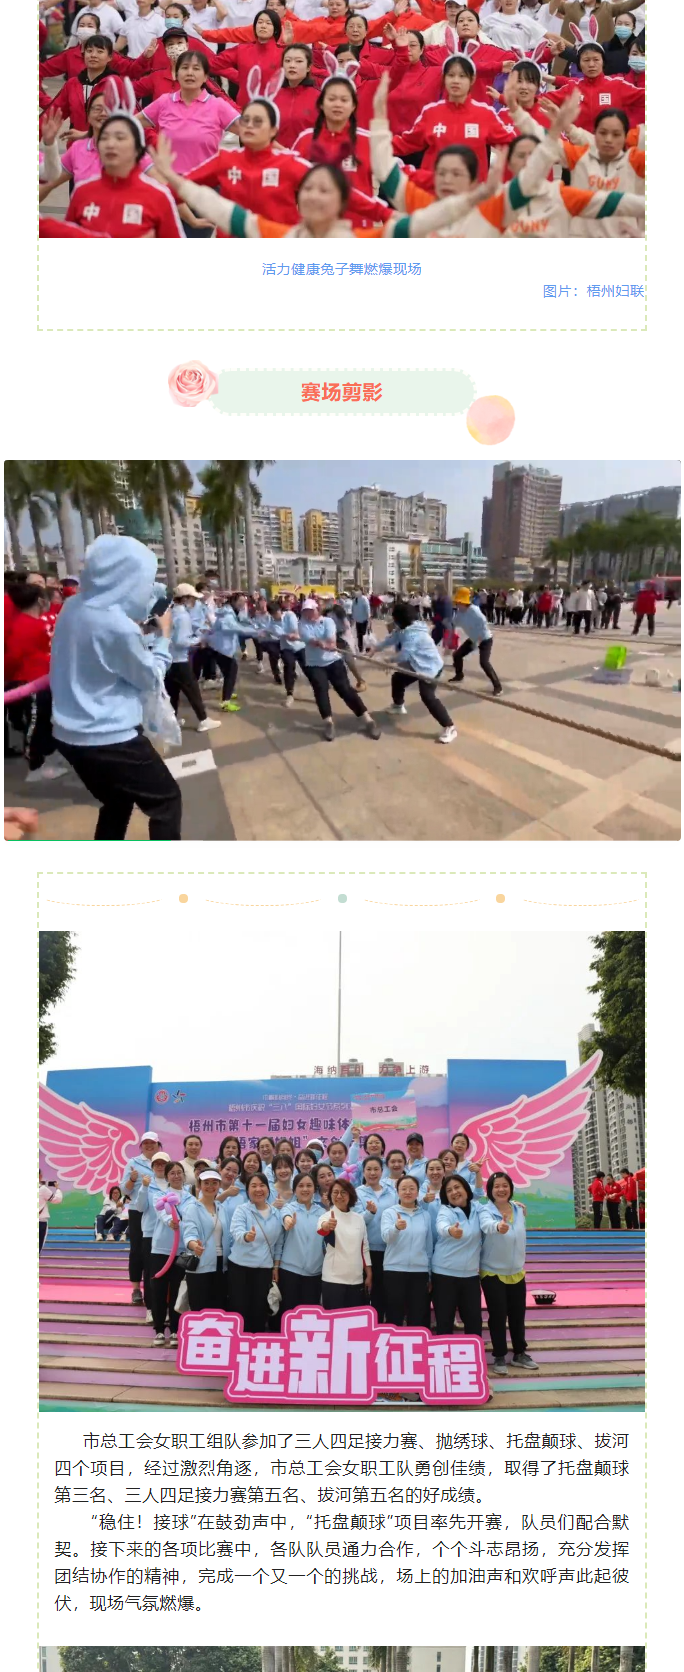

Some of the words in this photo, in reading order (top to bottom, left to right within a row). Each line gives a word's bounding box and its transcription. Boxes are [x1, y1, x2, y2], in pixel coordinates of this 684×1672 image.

[433, 122, 447, 138] 中
[227, 166, 242, 185] 中
[83, 201, 100, 221] 中
[369, 1105, 398, 1114] 市总工会
[185, 1313, 480, 1395] 奋进新征程
